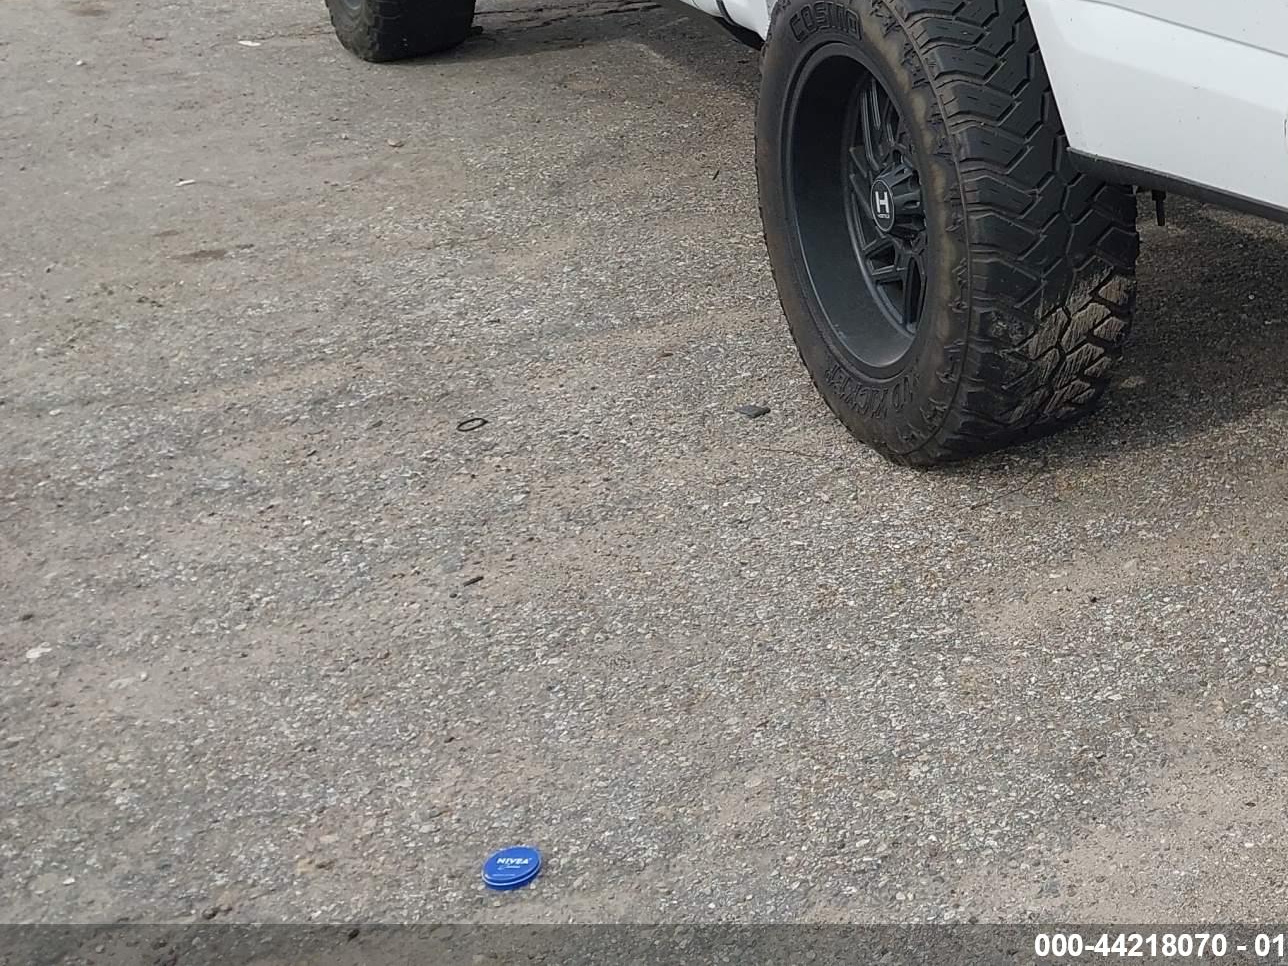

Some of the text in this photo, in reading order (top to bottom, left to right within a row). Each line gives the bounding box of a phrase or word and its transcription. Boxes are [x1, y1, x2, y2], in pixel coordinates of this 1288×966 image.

[789, 1, 863, 43] COSMO
[875, 191, 890, 213] H
[496, 857, 529, 865] NIVEA
